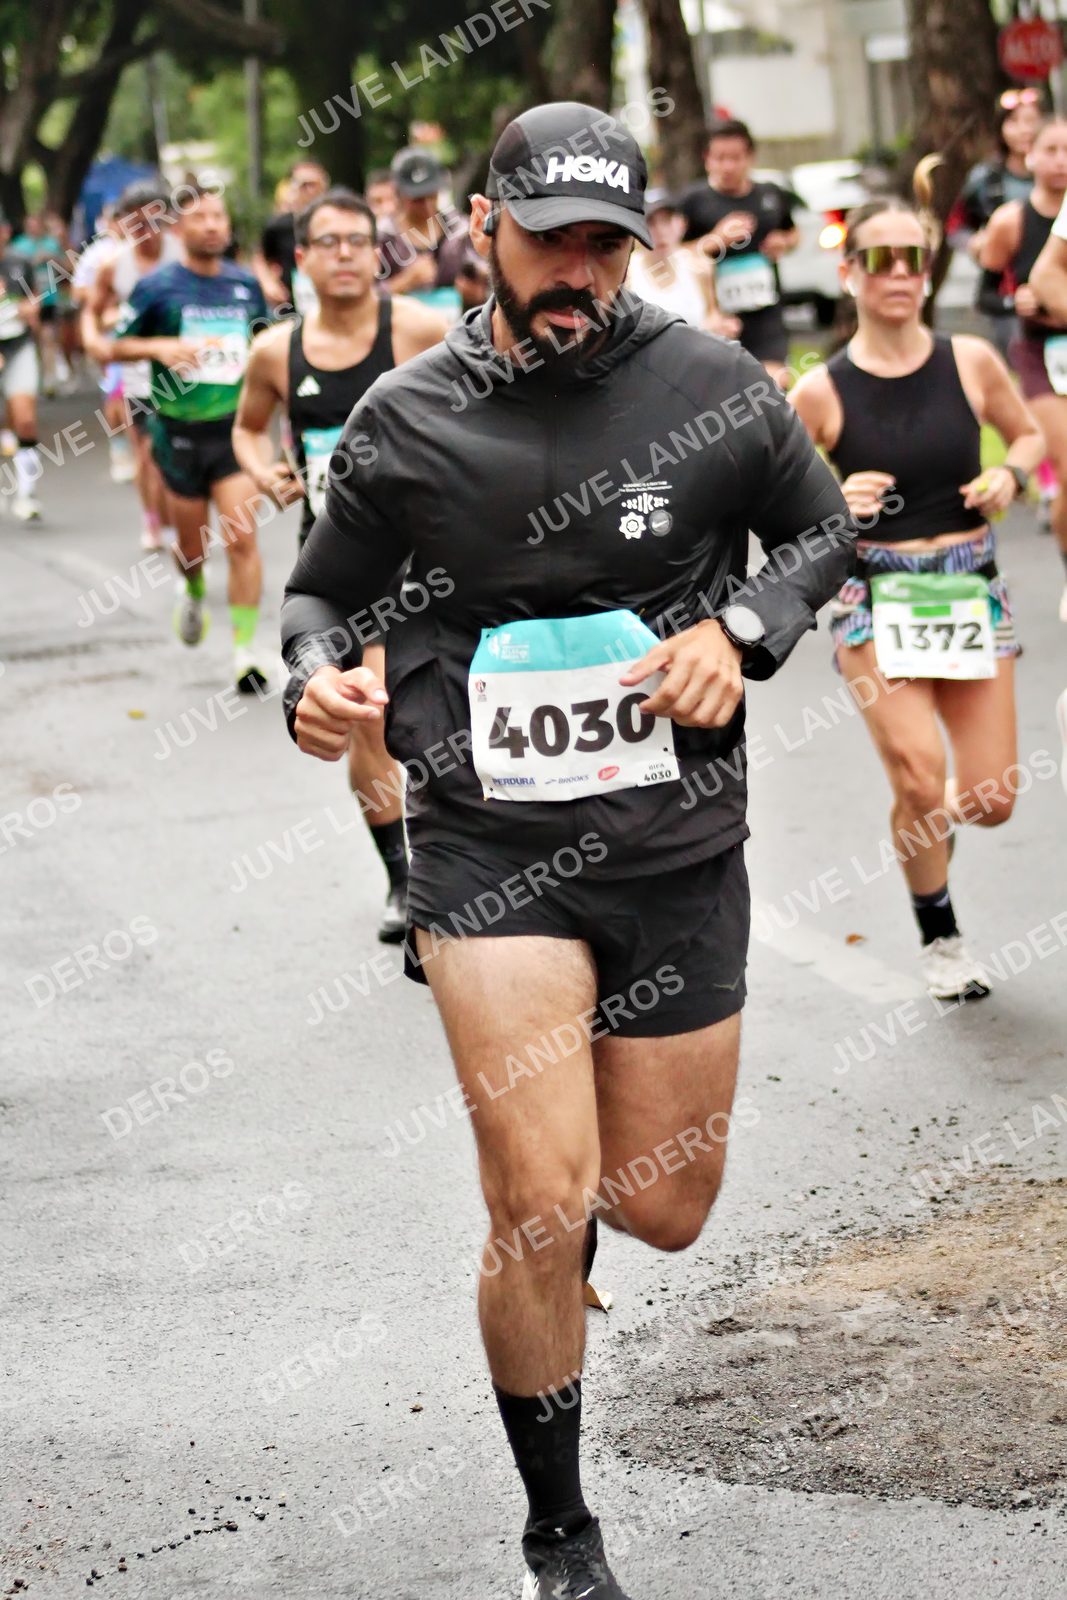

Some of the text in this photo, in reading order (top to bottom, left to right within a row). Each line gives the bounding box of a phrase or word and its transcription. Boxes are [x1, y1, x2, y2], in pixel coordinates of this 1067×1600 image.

[546, 155, 629, 194] HOKA
[886, 622, 983, 650] 1372
[488, 692, 656, 759] 4030
[492, 777, 536, 786] PERDURA
[644, 770, 671, 782] 4030
